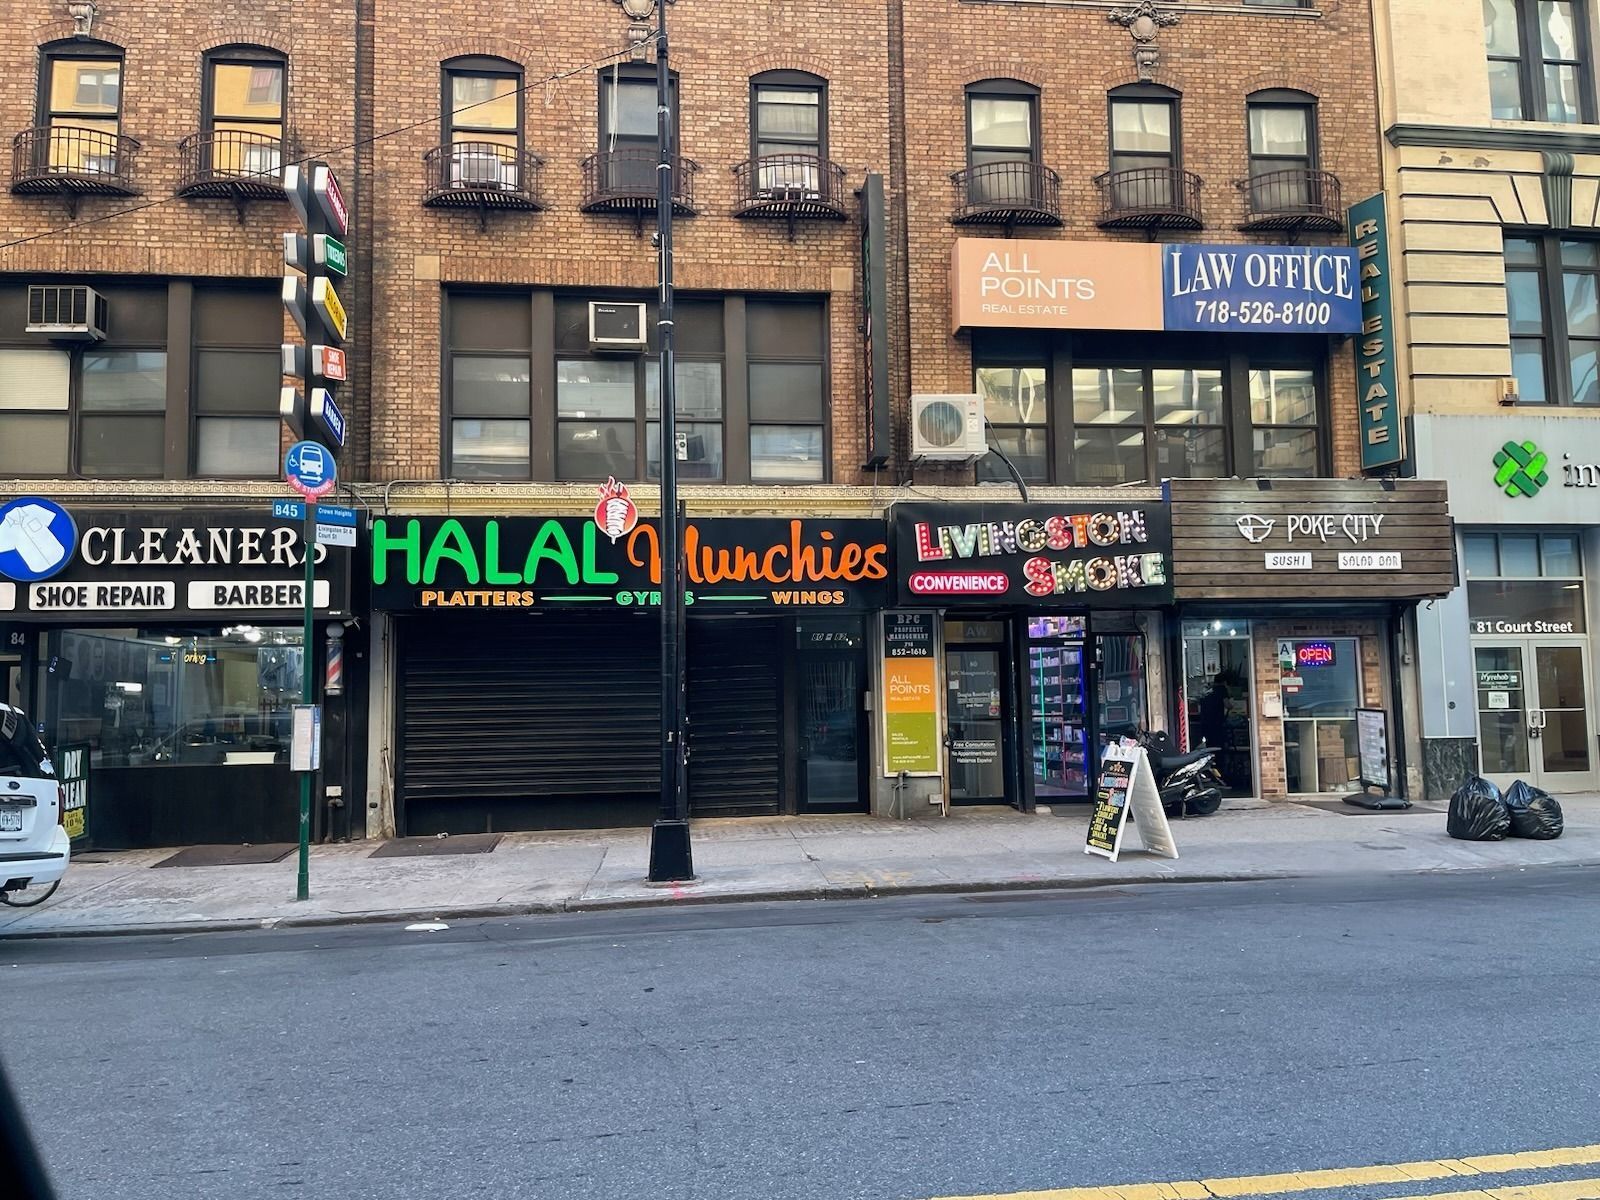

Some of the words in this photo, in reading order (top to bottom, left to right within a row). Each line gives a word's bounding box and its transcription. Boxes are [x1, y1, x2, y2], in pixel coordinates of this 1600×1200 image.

[326, 243, 345, 267] TUXEDOS
[981, 252, 1040, 273] ALL
[1355, 218, 1381, 302] REAL
[1170, 252, 1237, 297] LAW
[1244, 253, 1353, 300] OFFICE
[981, 276, 1096, 300] POINTS
[982, 303, 1016, 314] REAL
[1018, 304, 1068, 315] ESTATE
[1195, 300, 1331, 325] 718-526-8100
[328, 350, 340, 363] SHOE
[327, 363, 342, 377] REPAIR
[1363, 315, 1389, 446] ESTATE
[325, 401, 342, 435] BARBER
[1563, 453, 1600, 487] in
[292, 478, 302, 488] NO
[302, 480, 334, 494] STANDING
[275, 504, 298, 517] B45
[318, 507, 334, 515] Crown
[334, 509, 352, 517] Heights
[318, 525, 342, 534] Livingston
[914, 510, 1148, 562] LIVINGSTON
[1287, 514, 1336, 543] POKE
[1342, 514, 1384, 544] CITY
[373, 519, 619, 585] HALAL
[627, 519, 888, 584] Munchies
[1272, 556, 1306, 566] SUSHI
[1342, 555, 1374, 566] SALAD
[1378, 555, 1399, 566] BAR
[1023, 552, 1166, 597] SMOKE
[913, 576, 1005, 591] CONVENIENCE
[36, 586, 88, 608] SHOE
[97, 585, 166, 606] REPAIR
[213, 584, 303, 605] BARBER
[421, 591, 535, 606] PLATTERS
[615, 591, 695, 606] GYRS
[771, 591, 845, 605] WINGS
[897, 614, 920, 624] BPC
[1476, 621, 1492, 633] 81
[1496, 620, 1532, 633] Court
[1534, 620, 1573, 633] Street
[11, 632, 25, 646] 84
[891, 648, 928, 656] 852-1616
[1280, 643, 1290, 656] A
[1299, 647, 1332, 662] OPEN
[890, 674, 911, 684] ALL
[890, 684, 931, 695] POINTS
[64, 749, 83, 780] DRY
